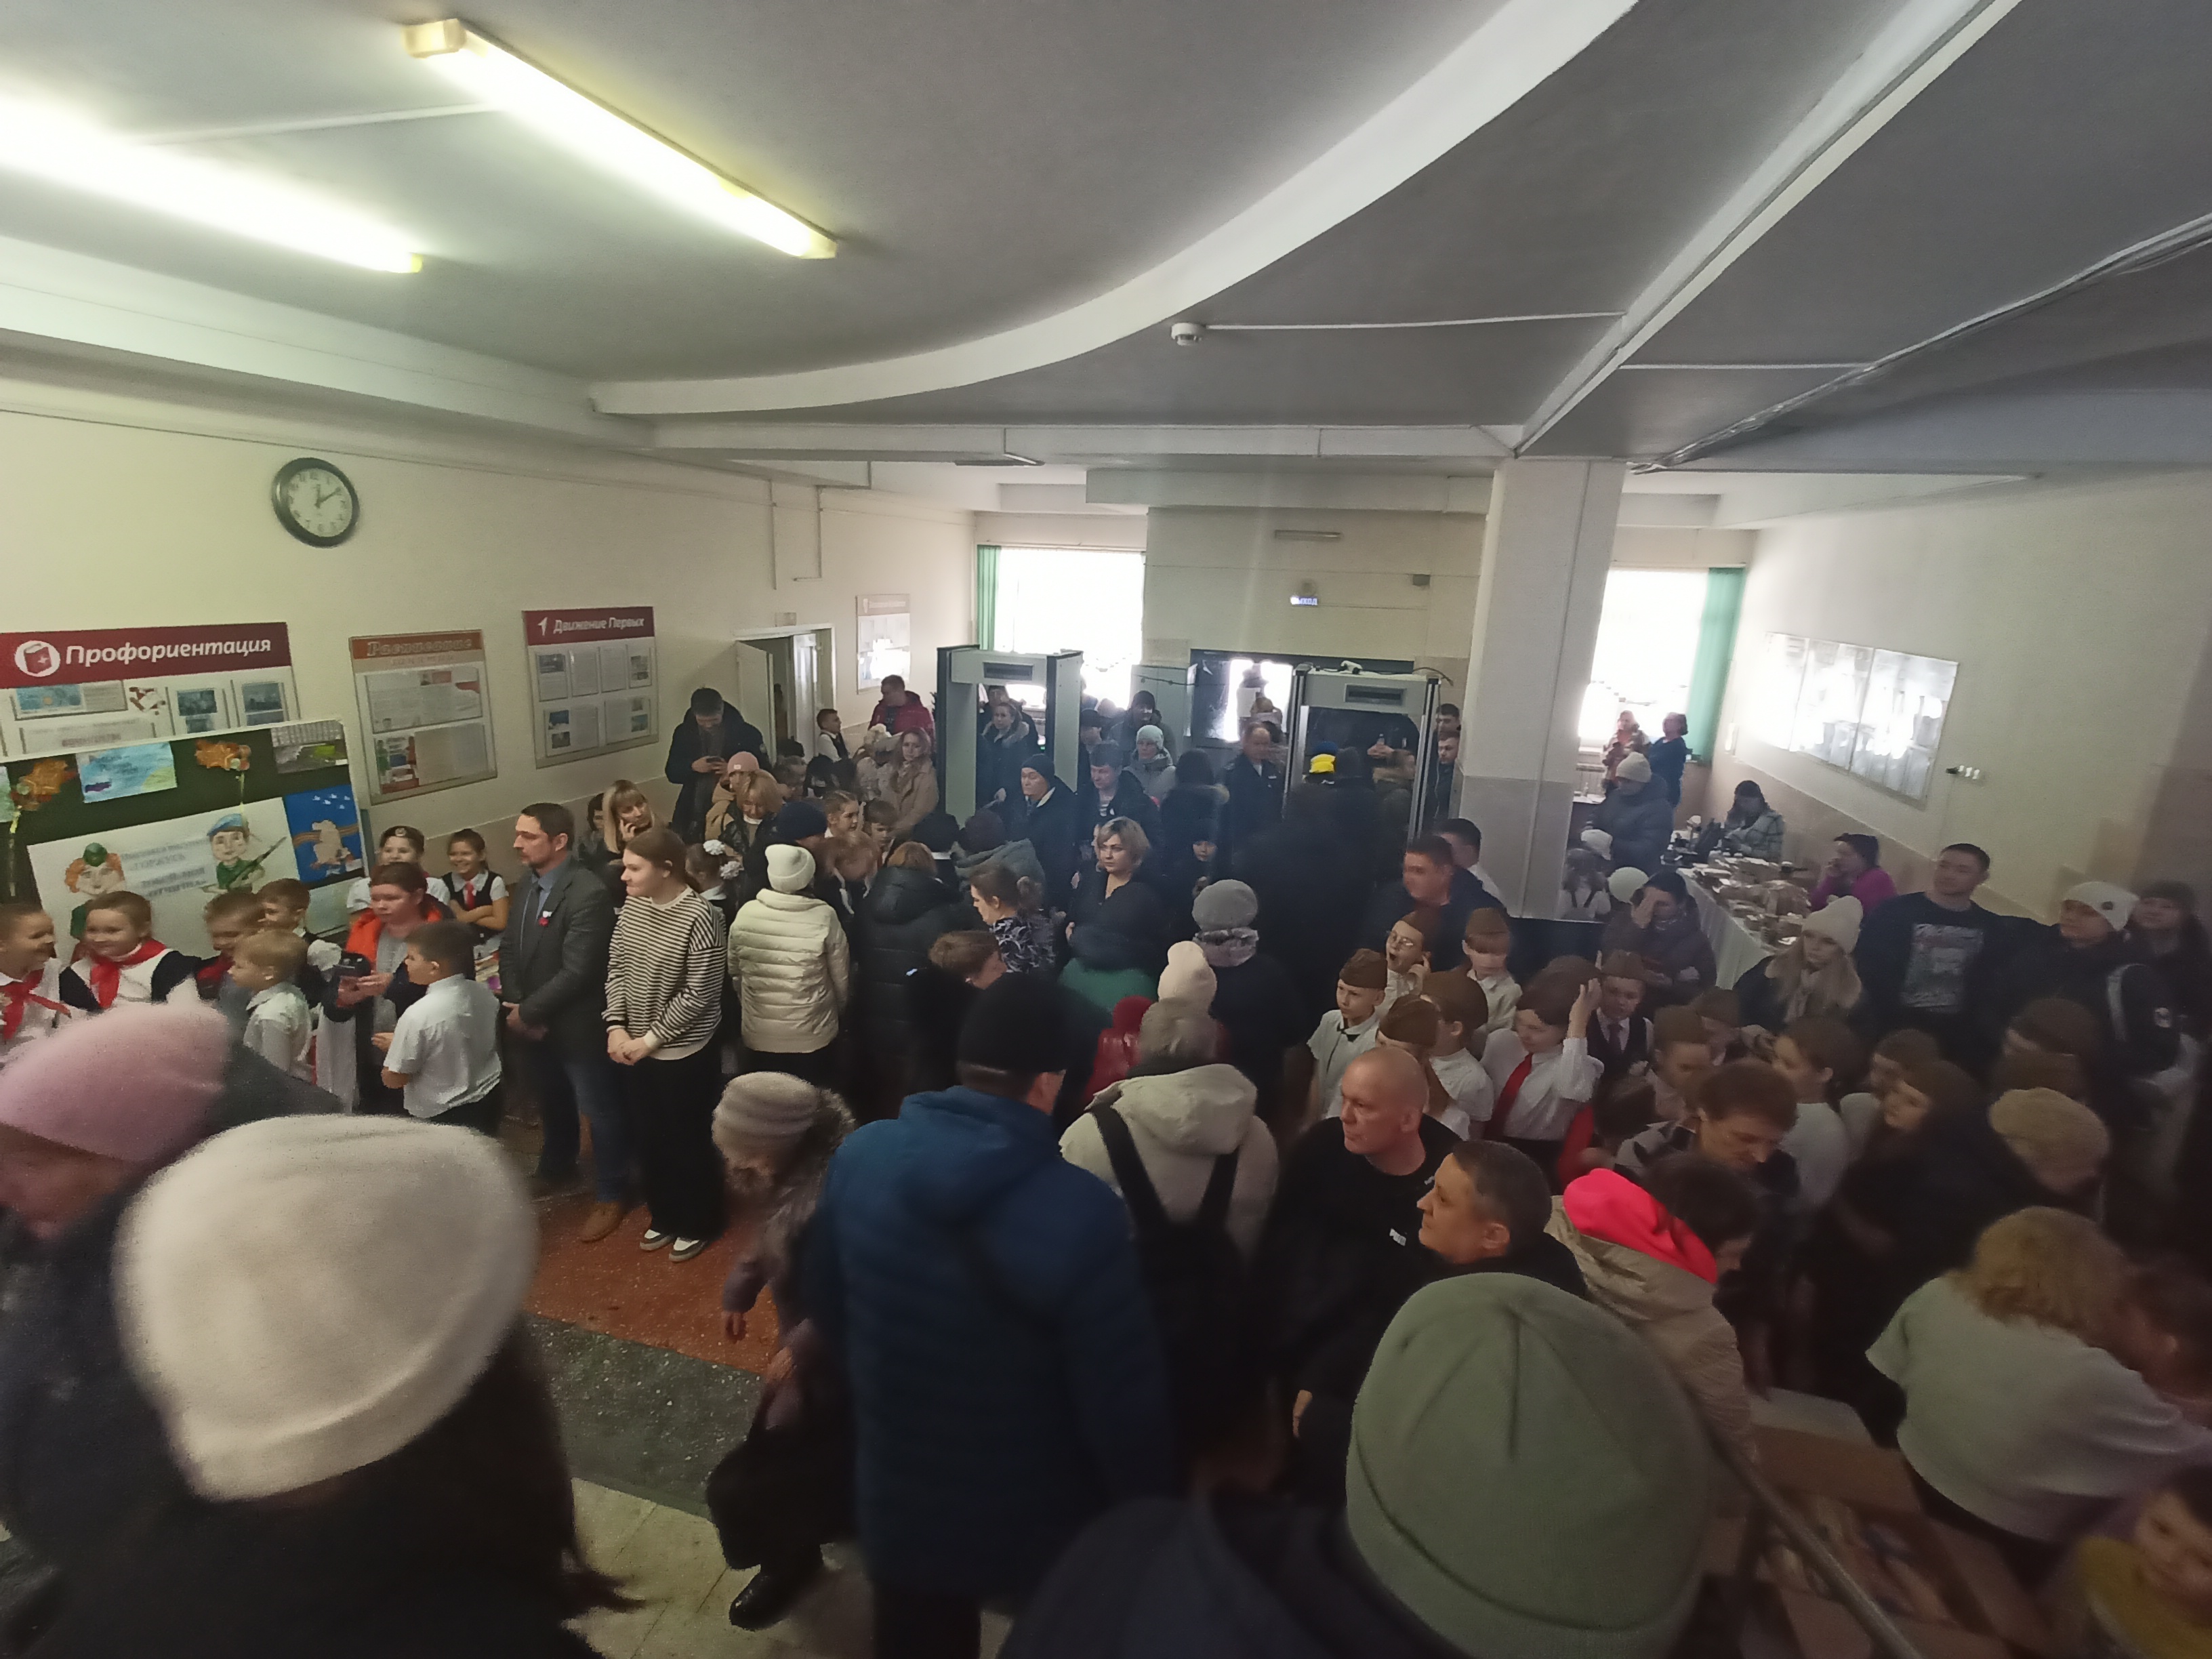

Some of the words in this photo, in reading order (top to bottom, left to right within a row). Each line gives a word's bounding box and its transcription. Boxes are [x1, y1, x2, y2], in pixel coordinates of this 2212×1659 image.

[553, 619, 607, 634] Движение
[609, 617, 644, 630] Первых
[66, 639, 271, 668] Профориентация
